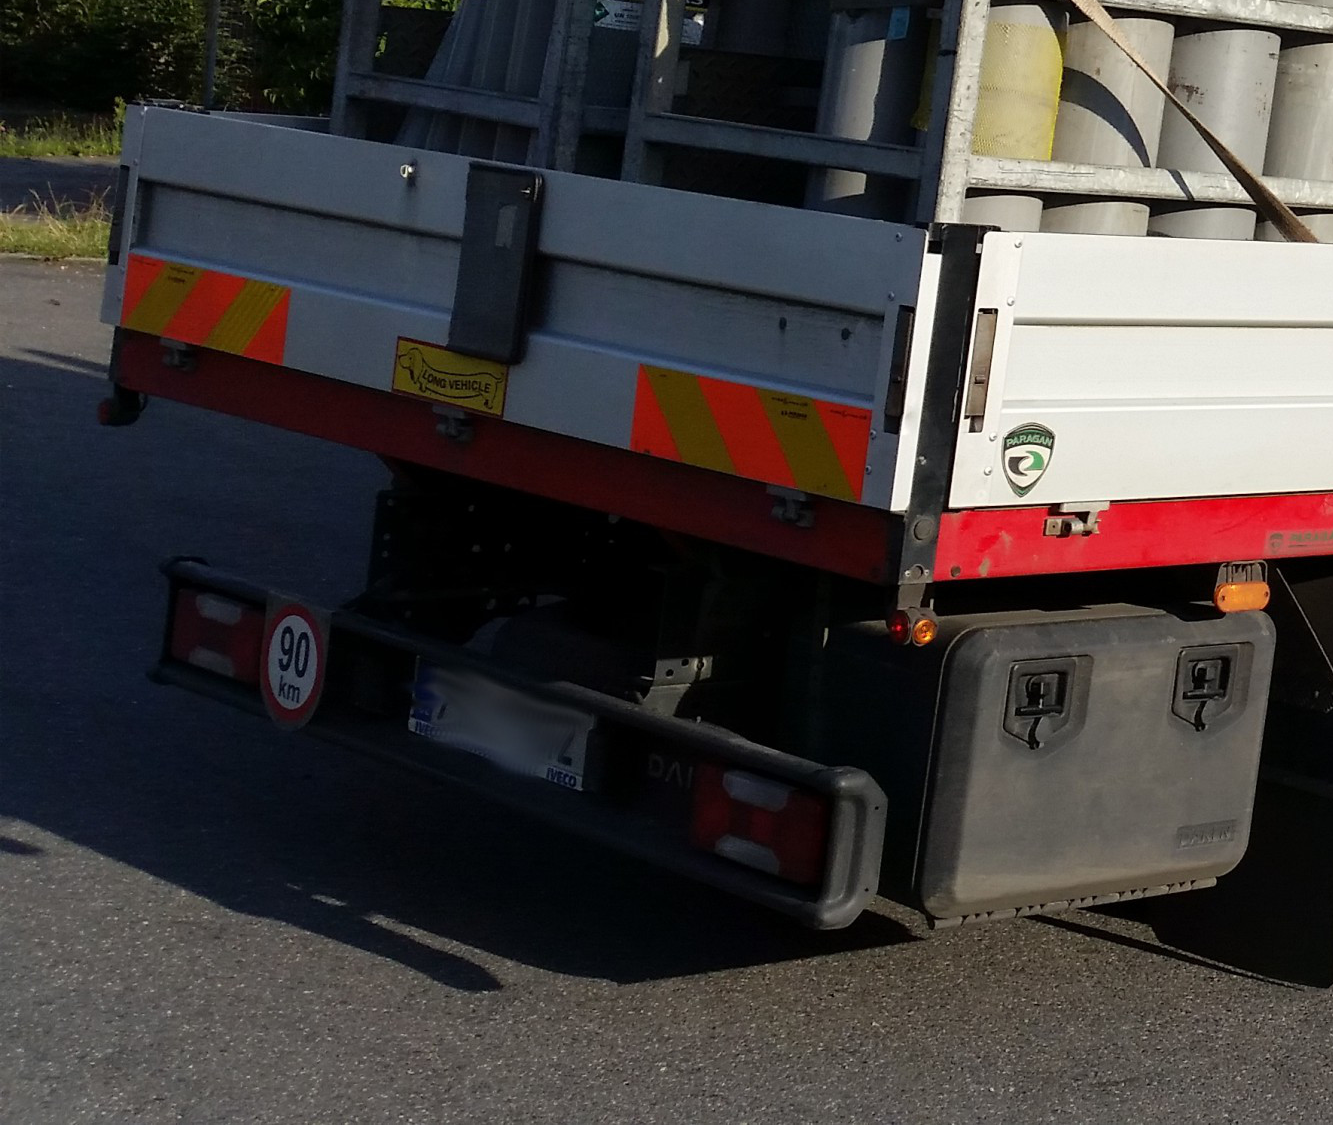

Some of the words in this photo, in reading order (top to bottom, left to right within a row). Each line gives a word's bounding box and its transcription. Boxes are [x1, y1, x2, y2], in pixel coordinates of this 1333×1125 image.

[421, 369, 447, 389] LONG
[449, 380, 491, 394] VEHICLE
[1006, 434, 1053, 447] PARAGAN
[278, 625, 310, 678] 90
[278, 675, 301, 704] km
[546, 766, 577, 788] IVECO
